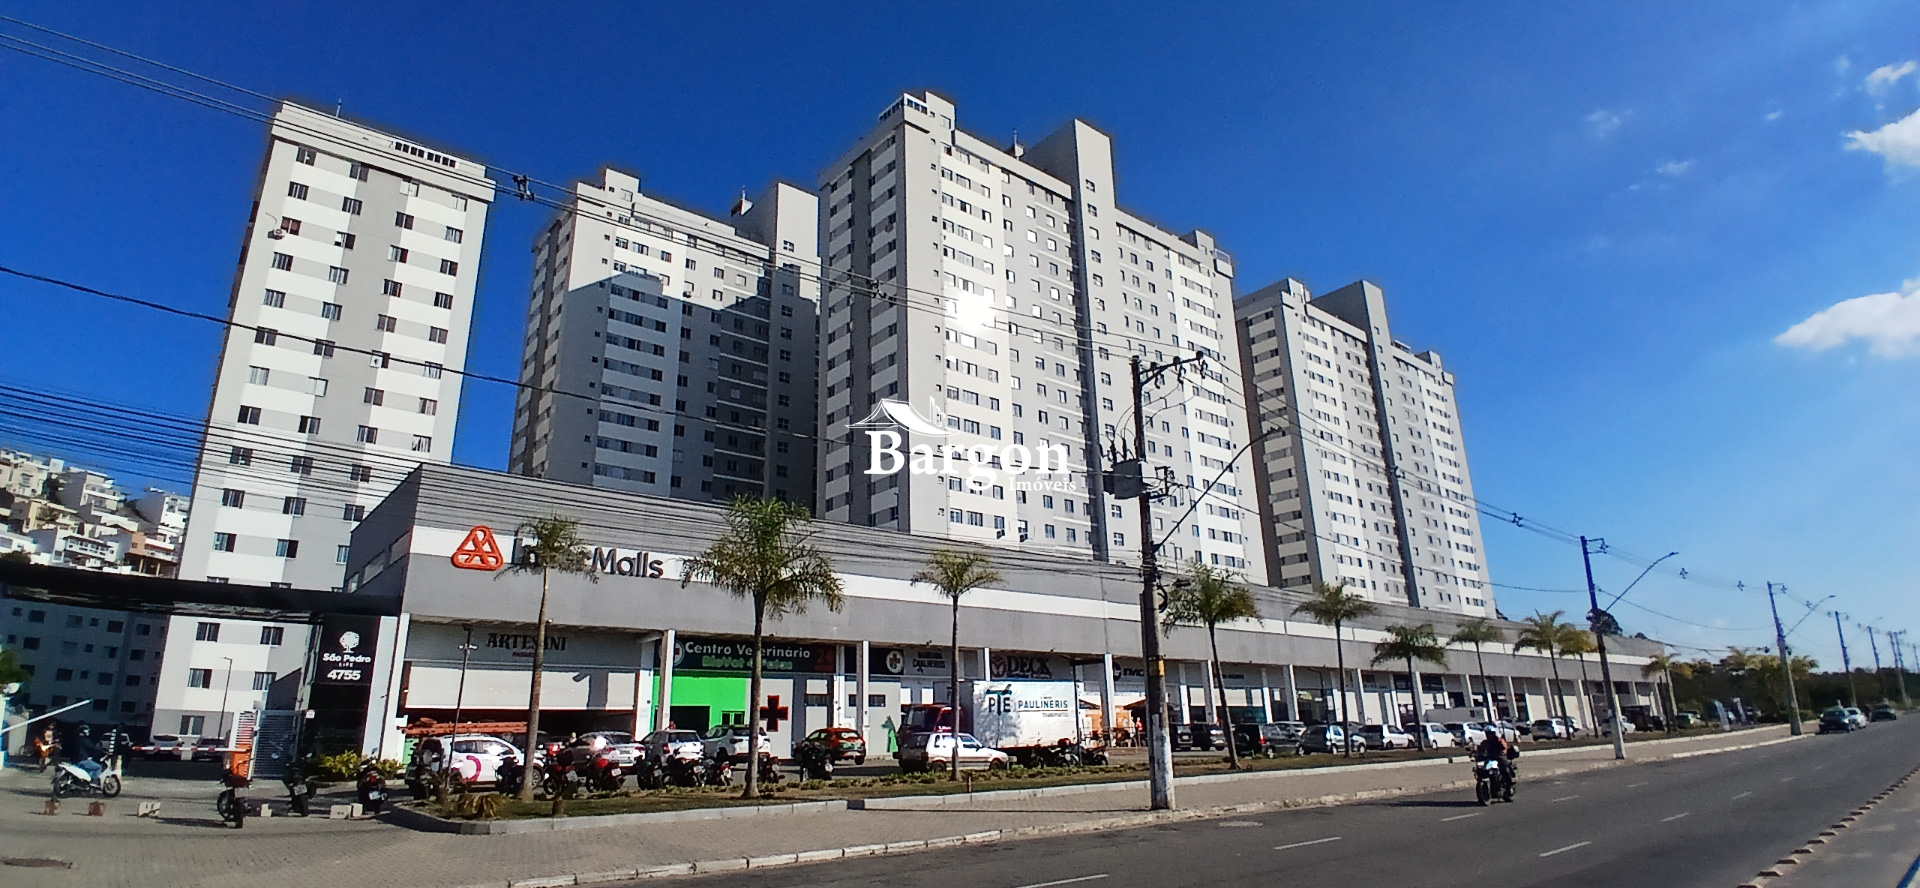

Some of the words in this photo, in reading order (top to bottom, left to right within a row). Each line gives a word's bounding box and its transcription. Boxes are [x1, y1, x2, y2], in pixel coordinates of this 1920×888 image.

[685, 641, 732, 656] Centro
[736, 643, 811, 659] Veerinário
[322, 652, 342, 662] São
[343, 653, 372, 663] Pedro
[1006, 655, 1051, 675] DECK
[327, 669, 362, 681] 4755
[1018, 700, 1068, 709] PAULINERIS
